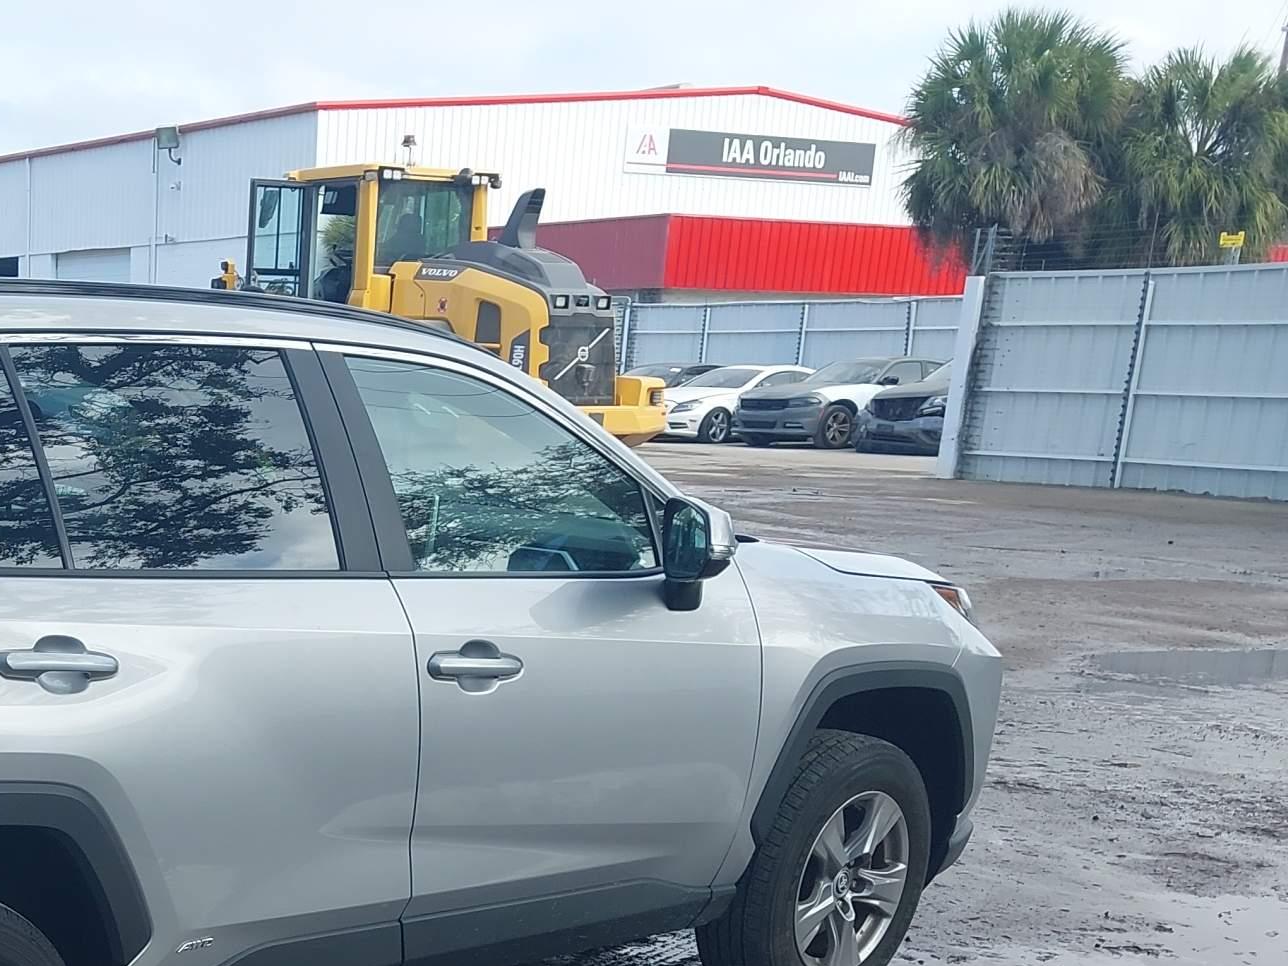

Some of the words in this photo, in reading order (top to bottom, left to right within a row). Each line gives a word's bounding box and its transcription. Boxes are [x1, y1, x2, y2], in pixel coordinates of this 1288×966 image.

[722, 137, 755, 164] IAA
[759, 140, 826, 169] Orlando
[421, 267, 458, 277] VOLVO
